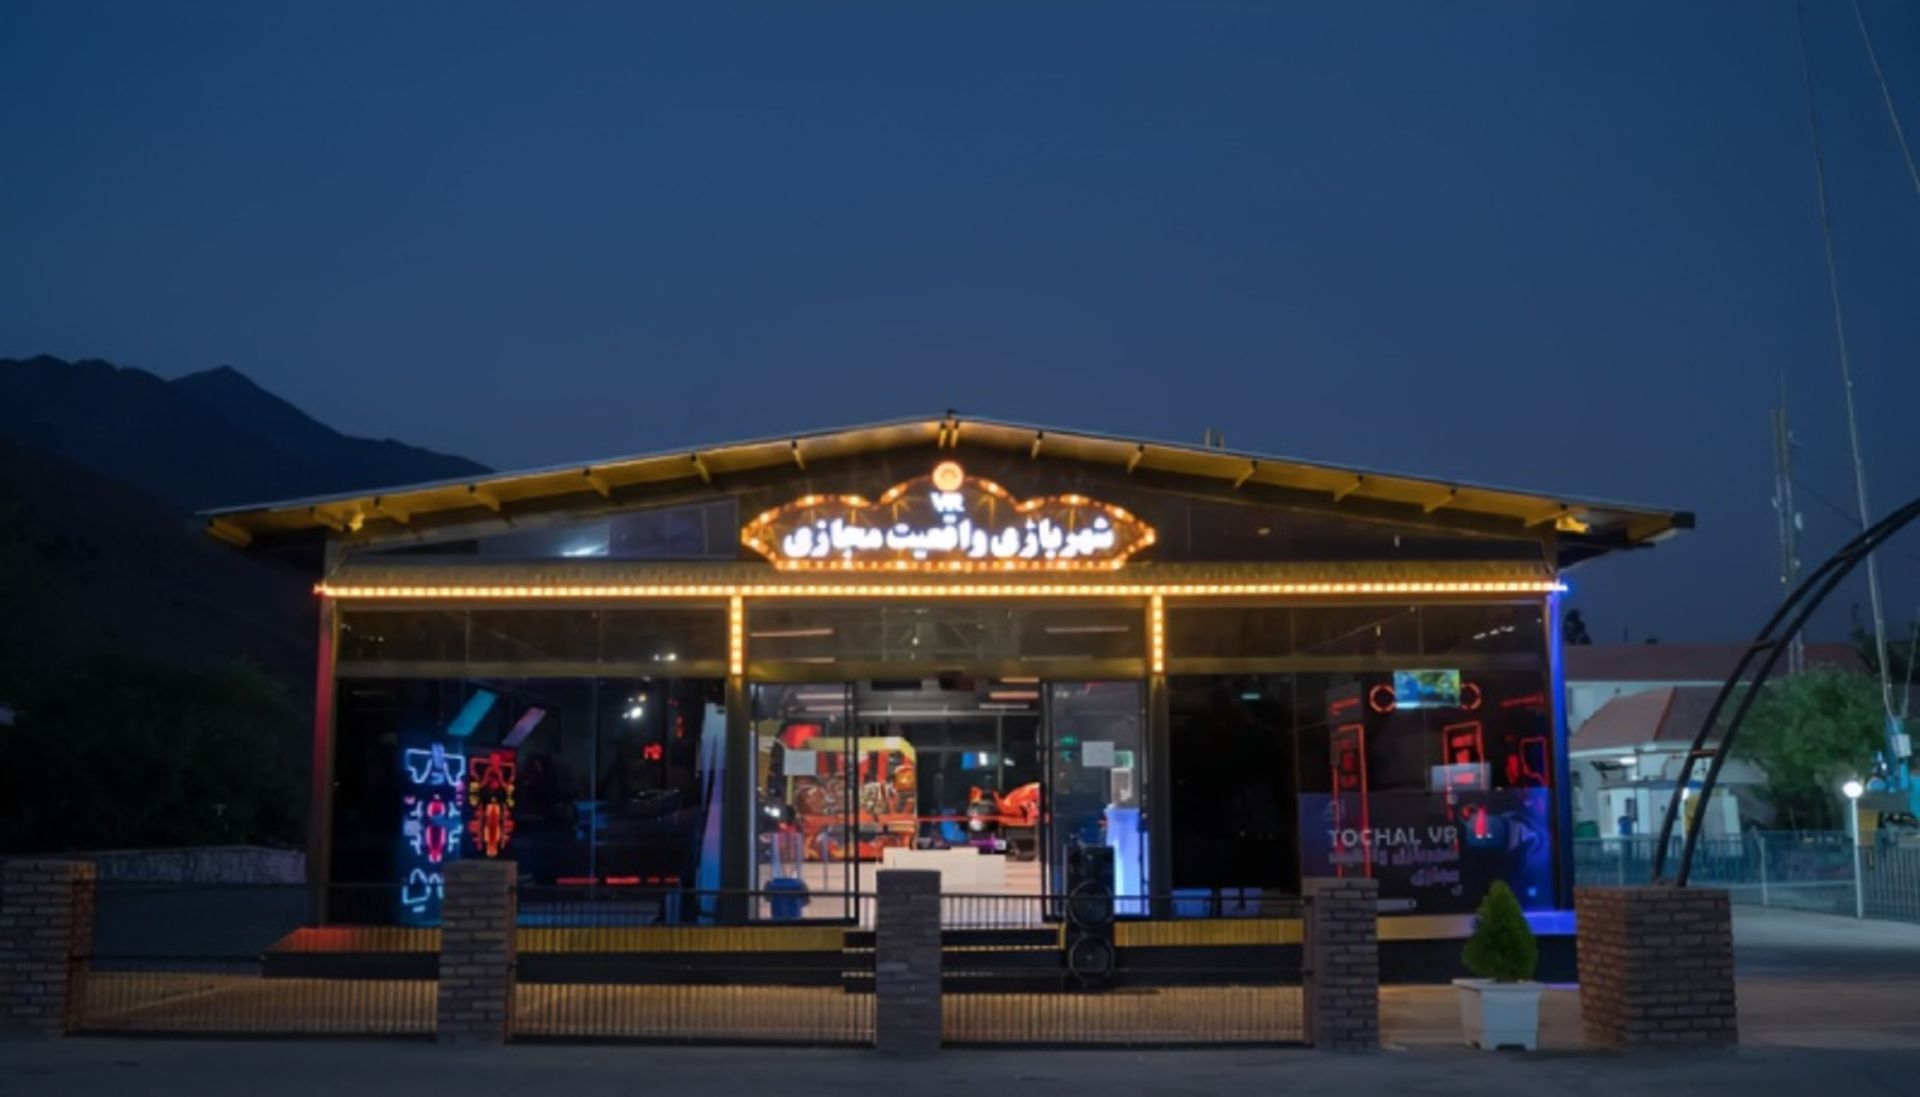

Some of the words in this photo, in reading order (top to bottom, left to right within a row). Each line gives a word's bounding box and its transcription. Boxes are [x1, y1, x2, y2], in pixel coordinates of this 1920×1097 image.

[930, 491, 965, 512] VR
[783, 517, 884, 560] مجازی
[886, 513, 987, 559] واقعیت
[1327, 826, 1422, 847] TOCHAL
[1427, 825, 1459, 844] VR
